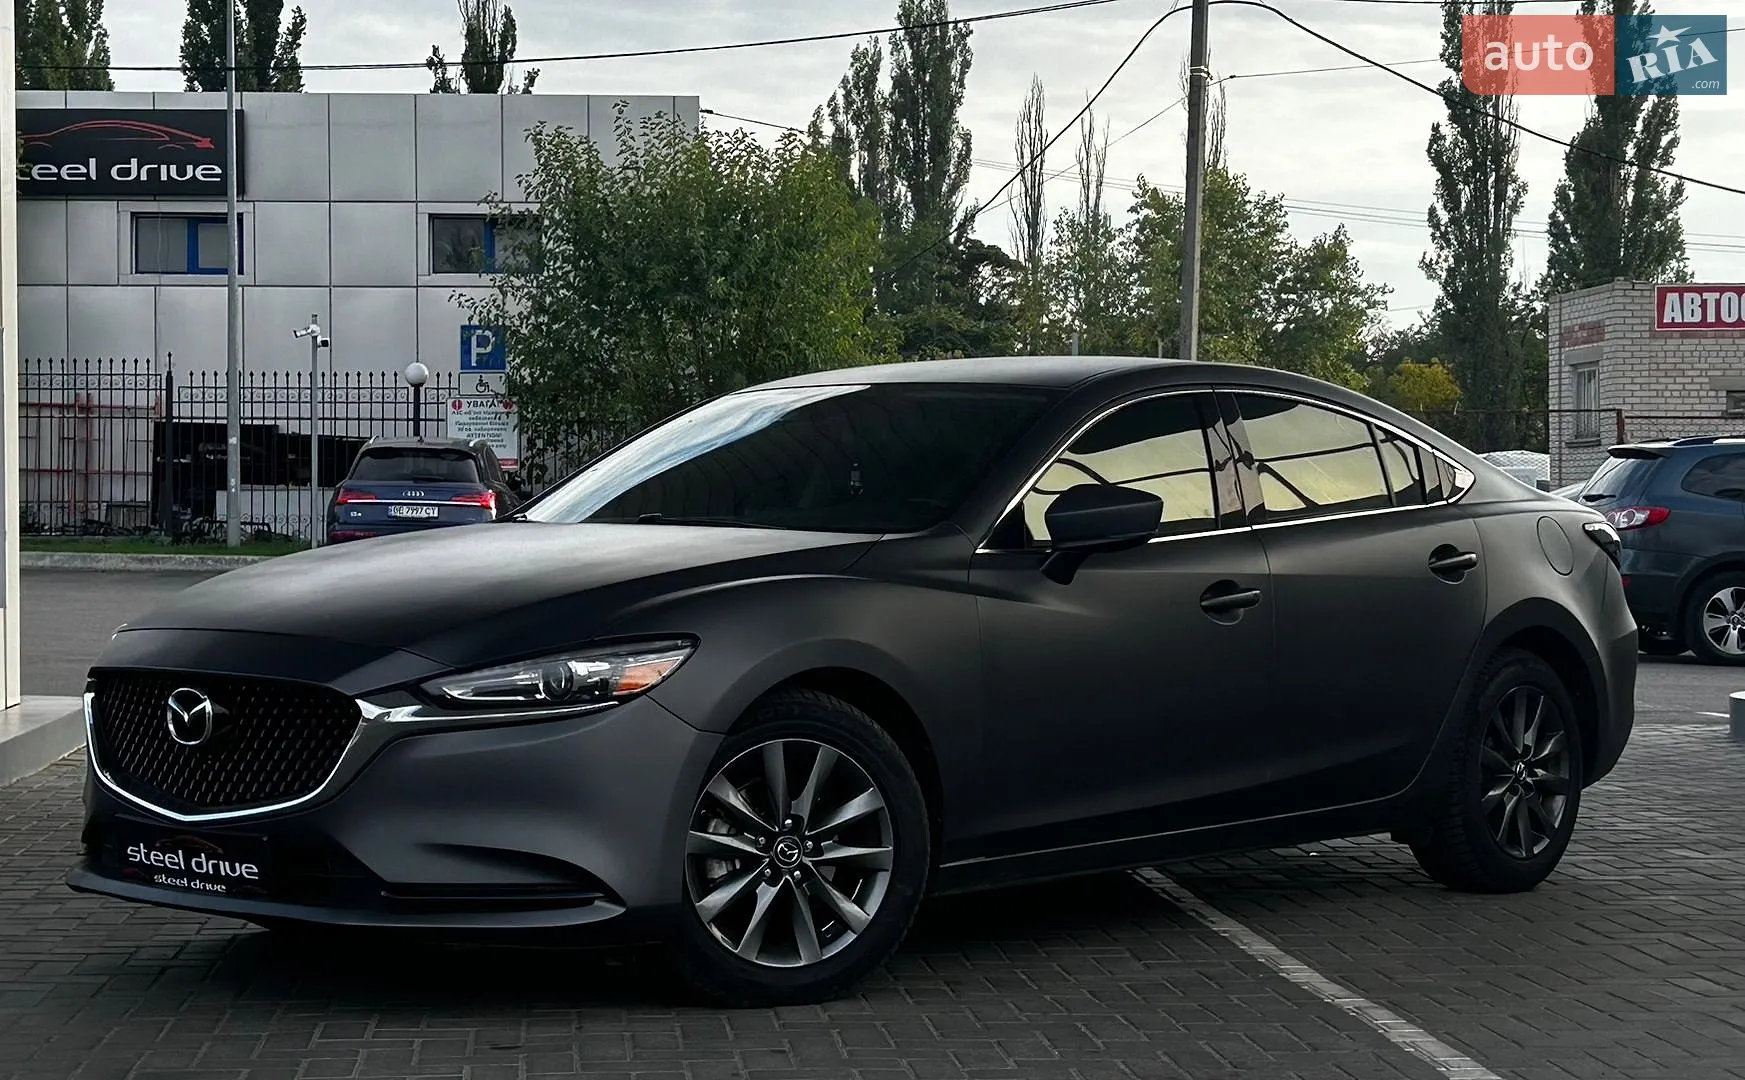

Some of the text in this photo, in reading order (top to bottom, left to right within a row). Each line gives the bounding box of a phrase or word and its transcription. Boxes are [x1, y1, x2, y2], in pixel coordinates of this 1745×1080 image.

[110, 158, 223, 181] drive
[1663, 292, 1745, 323] АВТО
[471, 329, 495, 366] P
[127, 843, 259, 880] steel drive
[154, 874, 227, 893] steel drive
